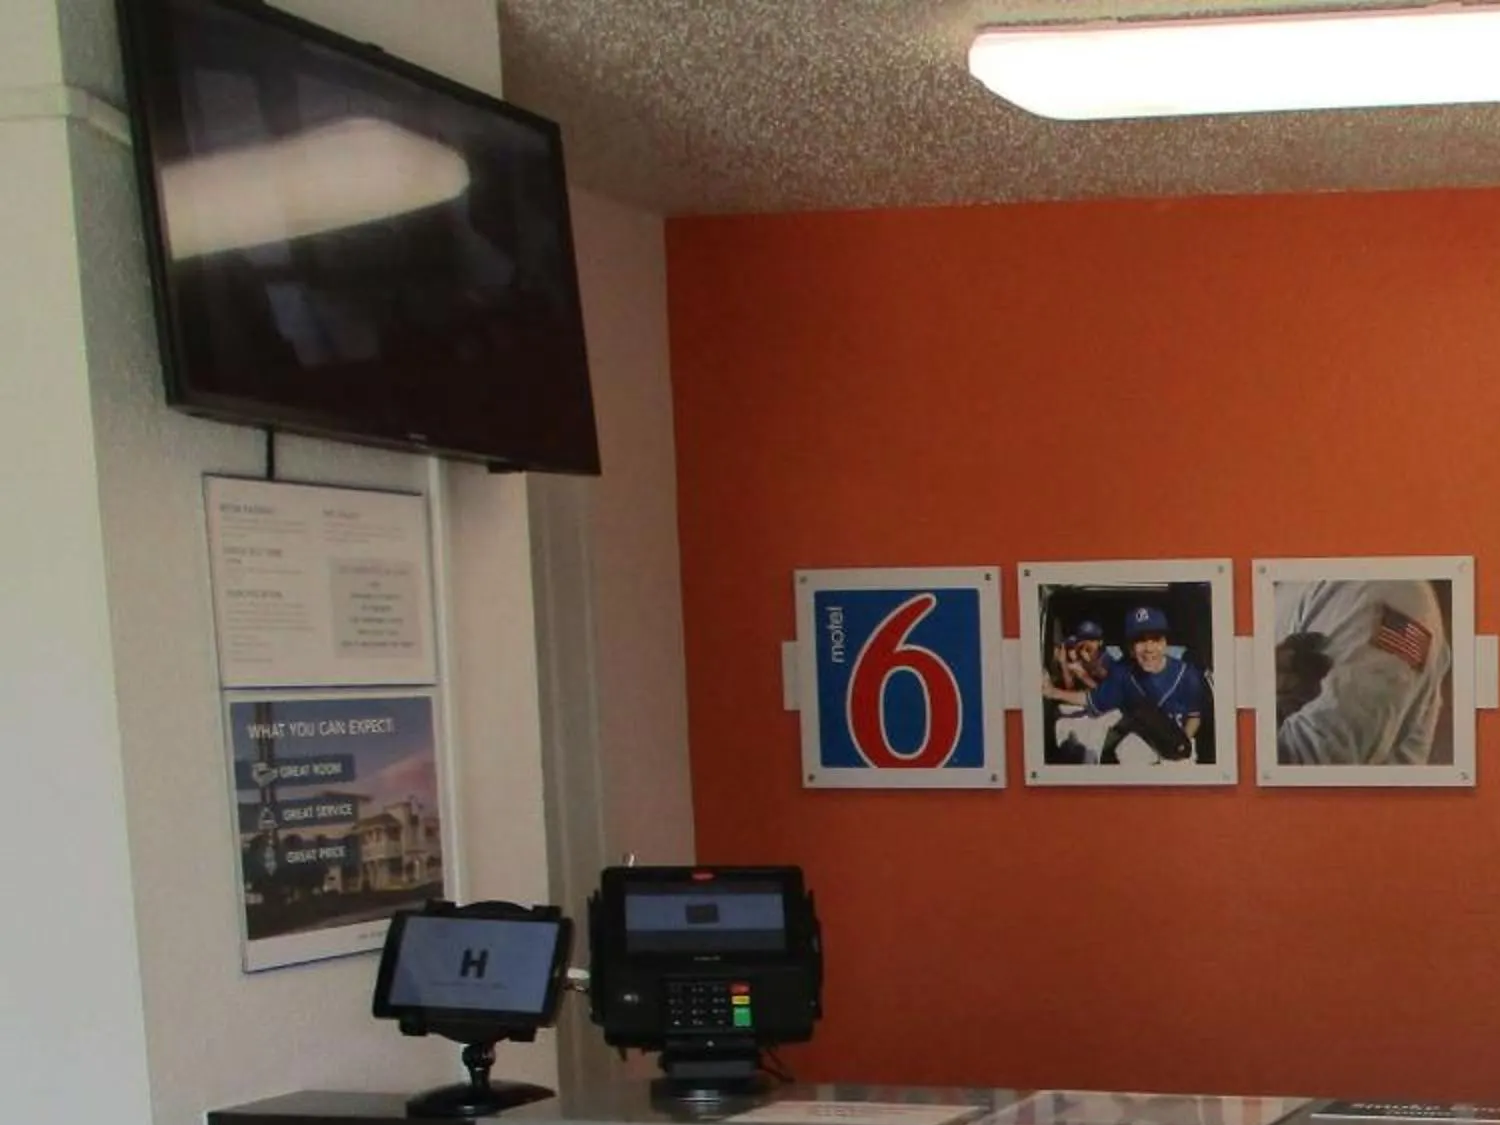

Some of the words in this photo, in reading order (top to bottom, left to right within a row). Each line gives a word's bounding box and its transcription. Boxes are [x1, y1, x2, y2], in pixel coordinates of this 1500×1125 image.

[826, 606, 845, 663] motel
[846, 593, 963, 769] 6
[247, 723, 285, 739] WHAT
[289, 721, 315, 737] YOU
[319, 719, 346, 735] CAN
[279, 765, 310, 779] GREAT
[282, 808, 313, 821] GREAT
[315, 804, 353, 817] SERVICE
[460, 948, 489, 979] H
